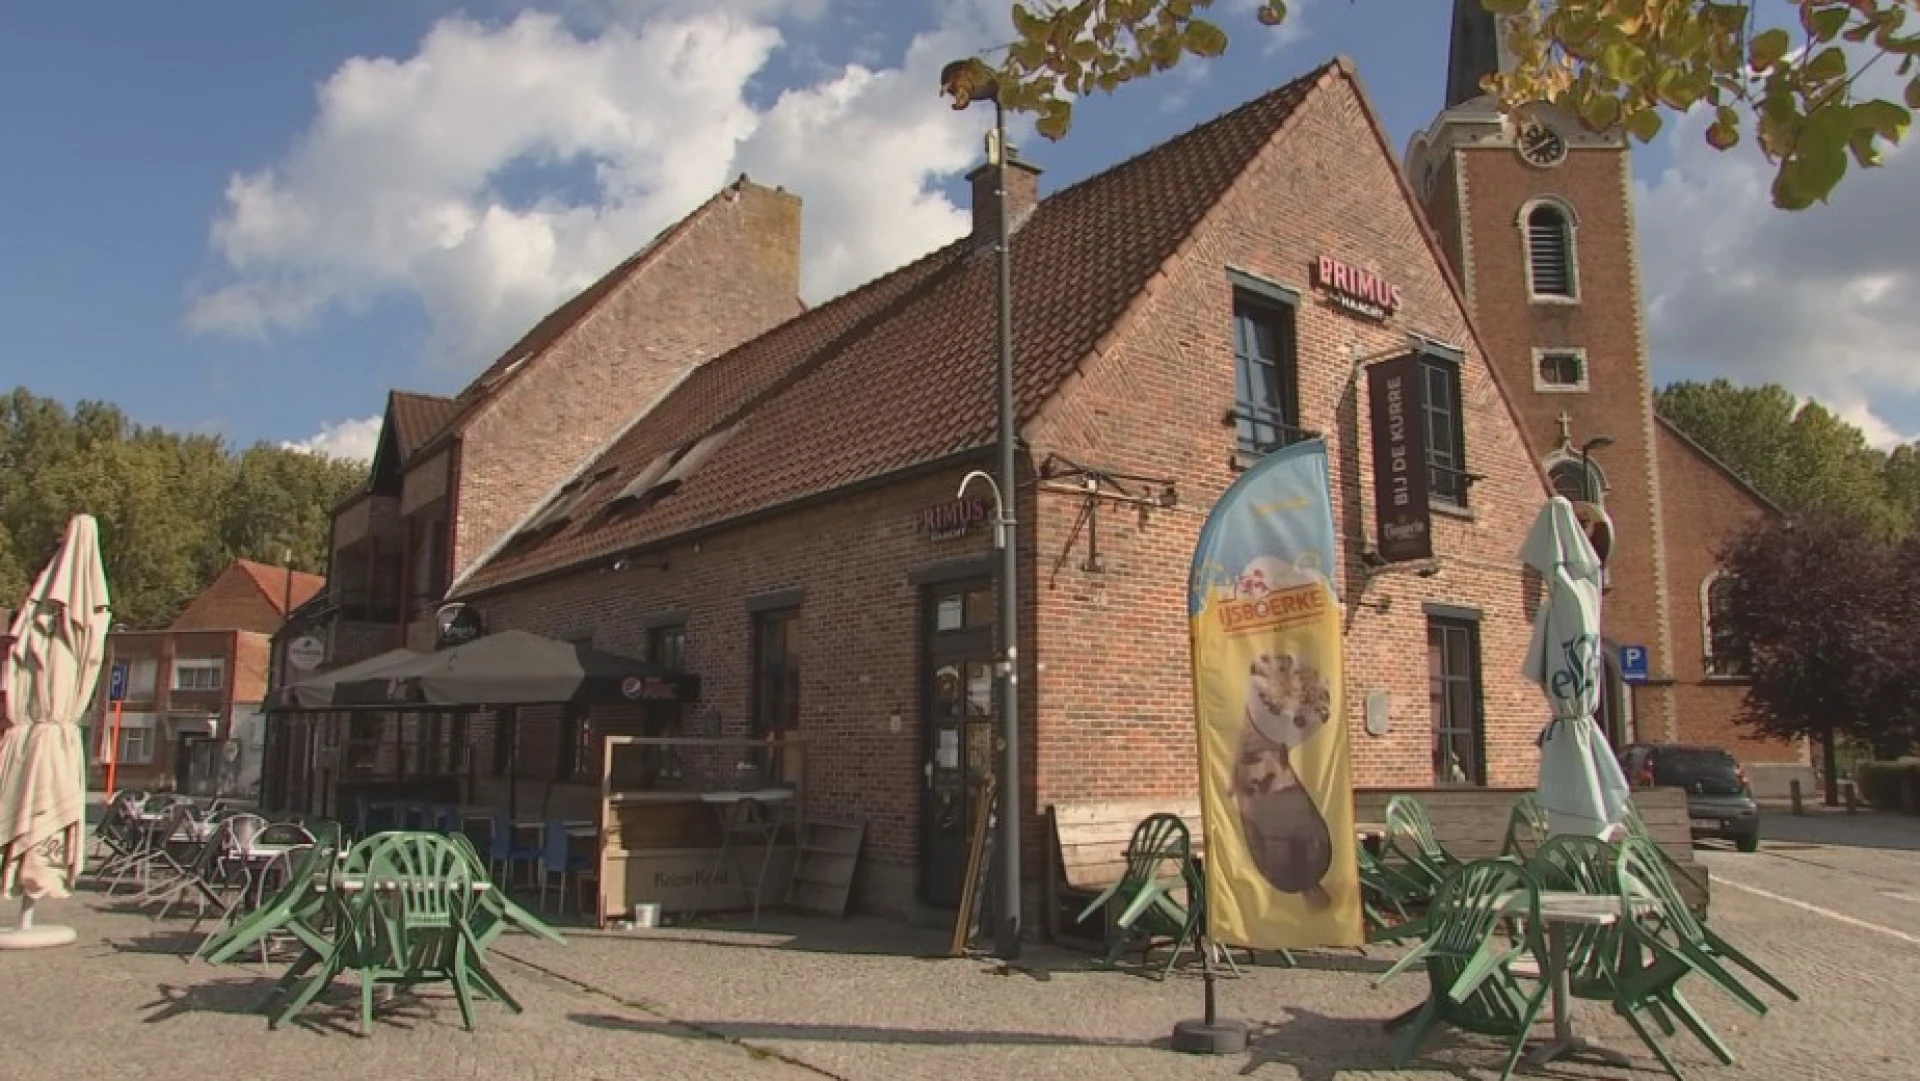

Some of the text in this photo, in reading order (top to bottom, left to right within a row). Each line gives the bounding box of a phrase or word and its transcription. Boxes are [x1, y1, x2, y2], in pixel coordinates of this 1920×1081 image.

[1319, 255, 1402, 310] PRIMUS
[1387, 376, 1408, 506] BIJ DE KURRE
[1626, 647, 1641, 668] P
